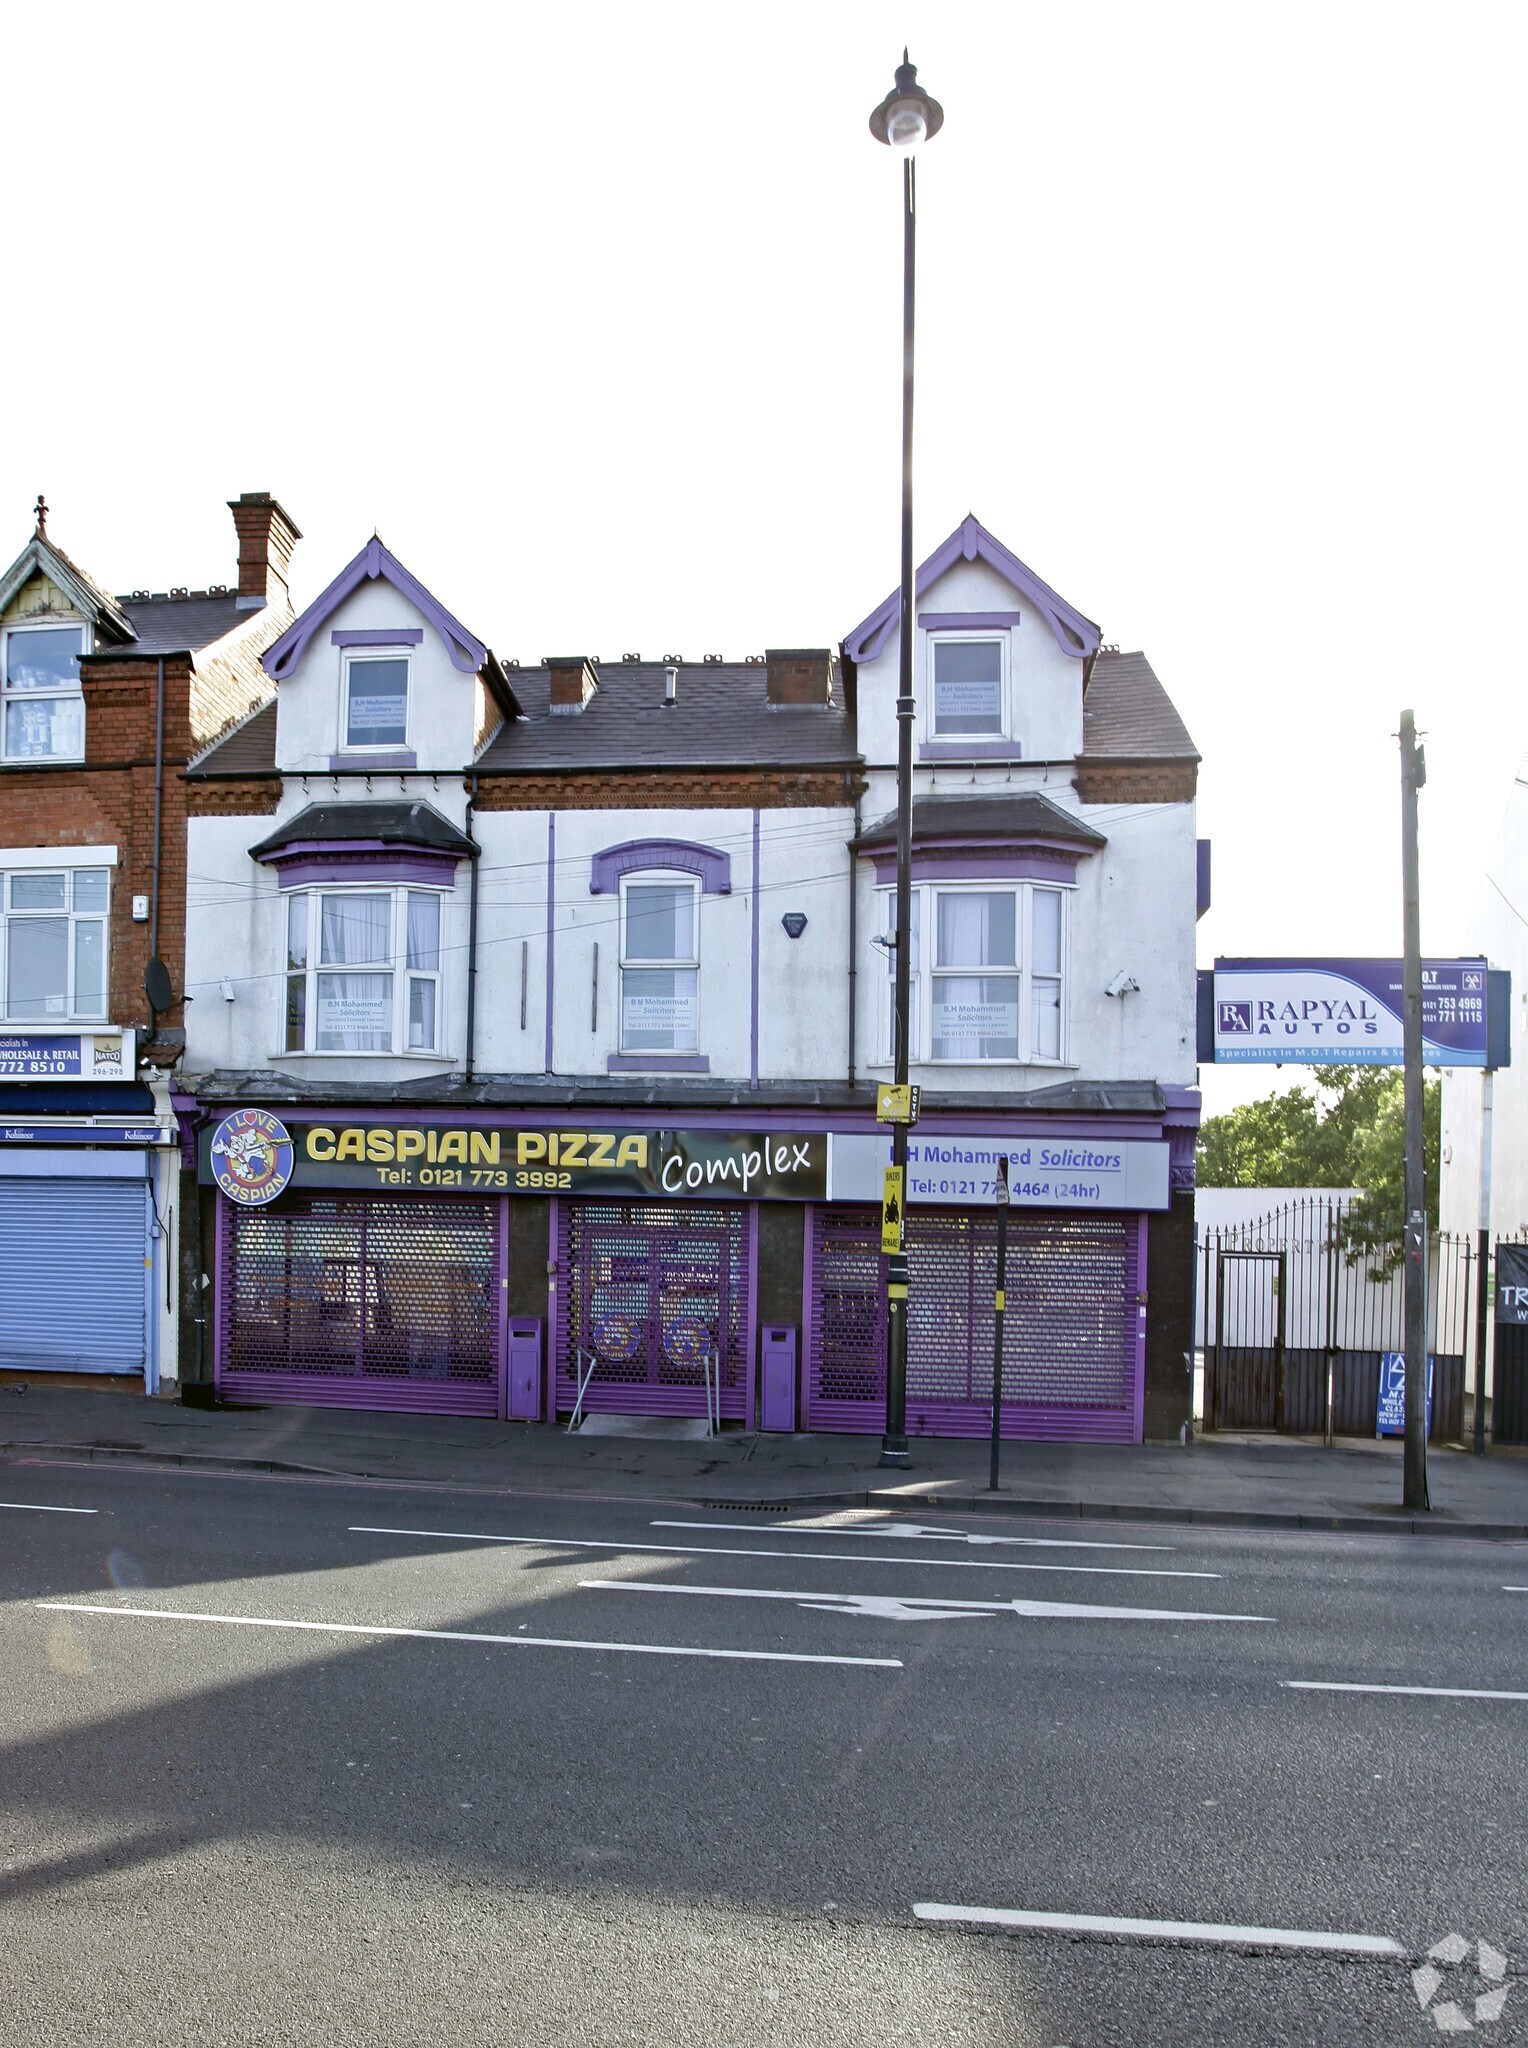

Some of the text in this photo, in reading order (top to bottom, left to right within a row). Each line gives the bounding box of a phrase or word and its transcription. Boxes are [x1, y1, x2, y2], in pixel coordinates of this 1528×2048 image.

[341, 1000, 383, 1008] Mohammed
[644, 998, 689, 1006] Mohammed
[1422, 997, 1482, 1010] 0121 753 4969
[643, 1006, 676, 1015] Solicitors
[959, 1004, 1006, 1013] Mohammed
[1257, 1000, 1377, 1021] RAPYAL
[957, 1014, 993, 1022] Solicitors
[1422, 1010, 1482, 1023] 0121 771 1115
[1258, 1022, 1378, 1035] AUTOS
[43, 1050, 50, 1060] &
[53, 1050, 79, 1060] RETAIL
[94, 1050, 121, 1062] NATCO
[1219, 1049, 1278, 1058] Specialist
[1295, 1049, 1329, 1057] M.O.T
[1333, 1049, 1377, 1058] Repairs
[1380, 1049, 1390, 1057] &
[0, 1061, 66, 1073] 772 8510
[92, 1068, 124, 1076] 296-298
[911, 1086, 919, 1118] CCTV
[306, 1128, 648, 1168] CASPIAN PIZZA
[924, 1145, 1031, 1166] Mohammed
[1039, 1149, 1121, 1168] Solicitors
[661, 1136, 811, 1193] Complex
[377, 1167, 572, 1189] Tel: 0121 773 3992
[885, 1171, 901, 1182] BIKERS
[220, 1172, 285, 1202] CASPIAN
[910, 1178, 937, 1194] Tel:
[939, 1179, 975, 1196] 0121
[981, 1181, 1003, 1197] 77
[1012, 1182, 1050, 1197] 4464
[1054, 1182, 1100, 1200] (24hr)
